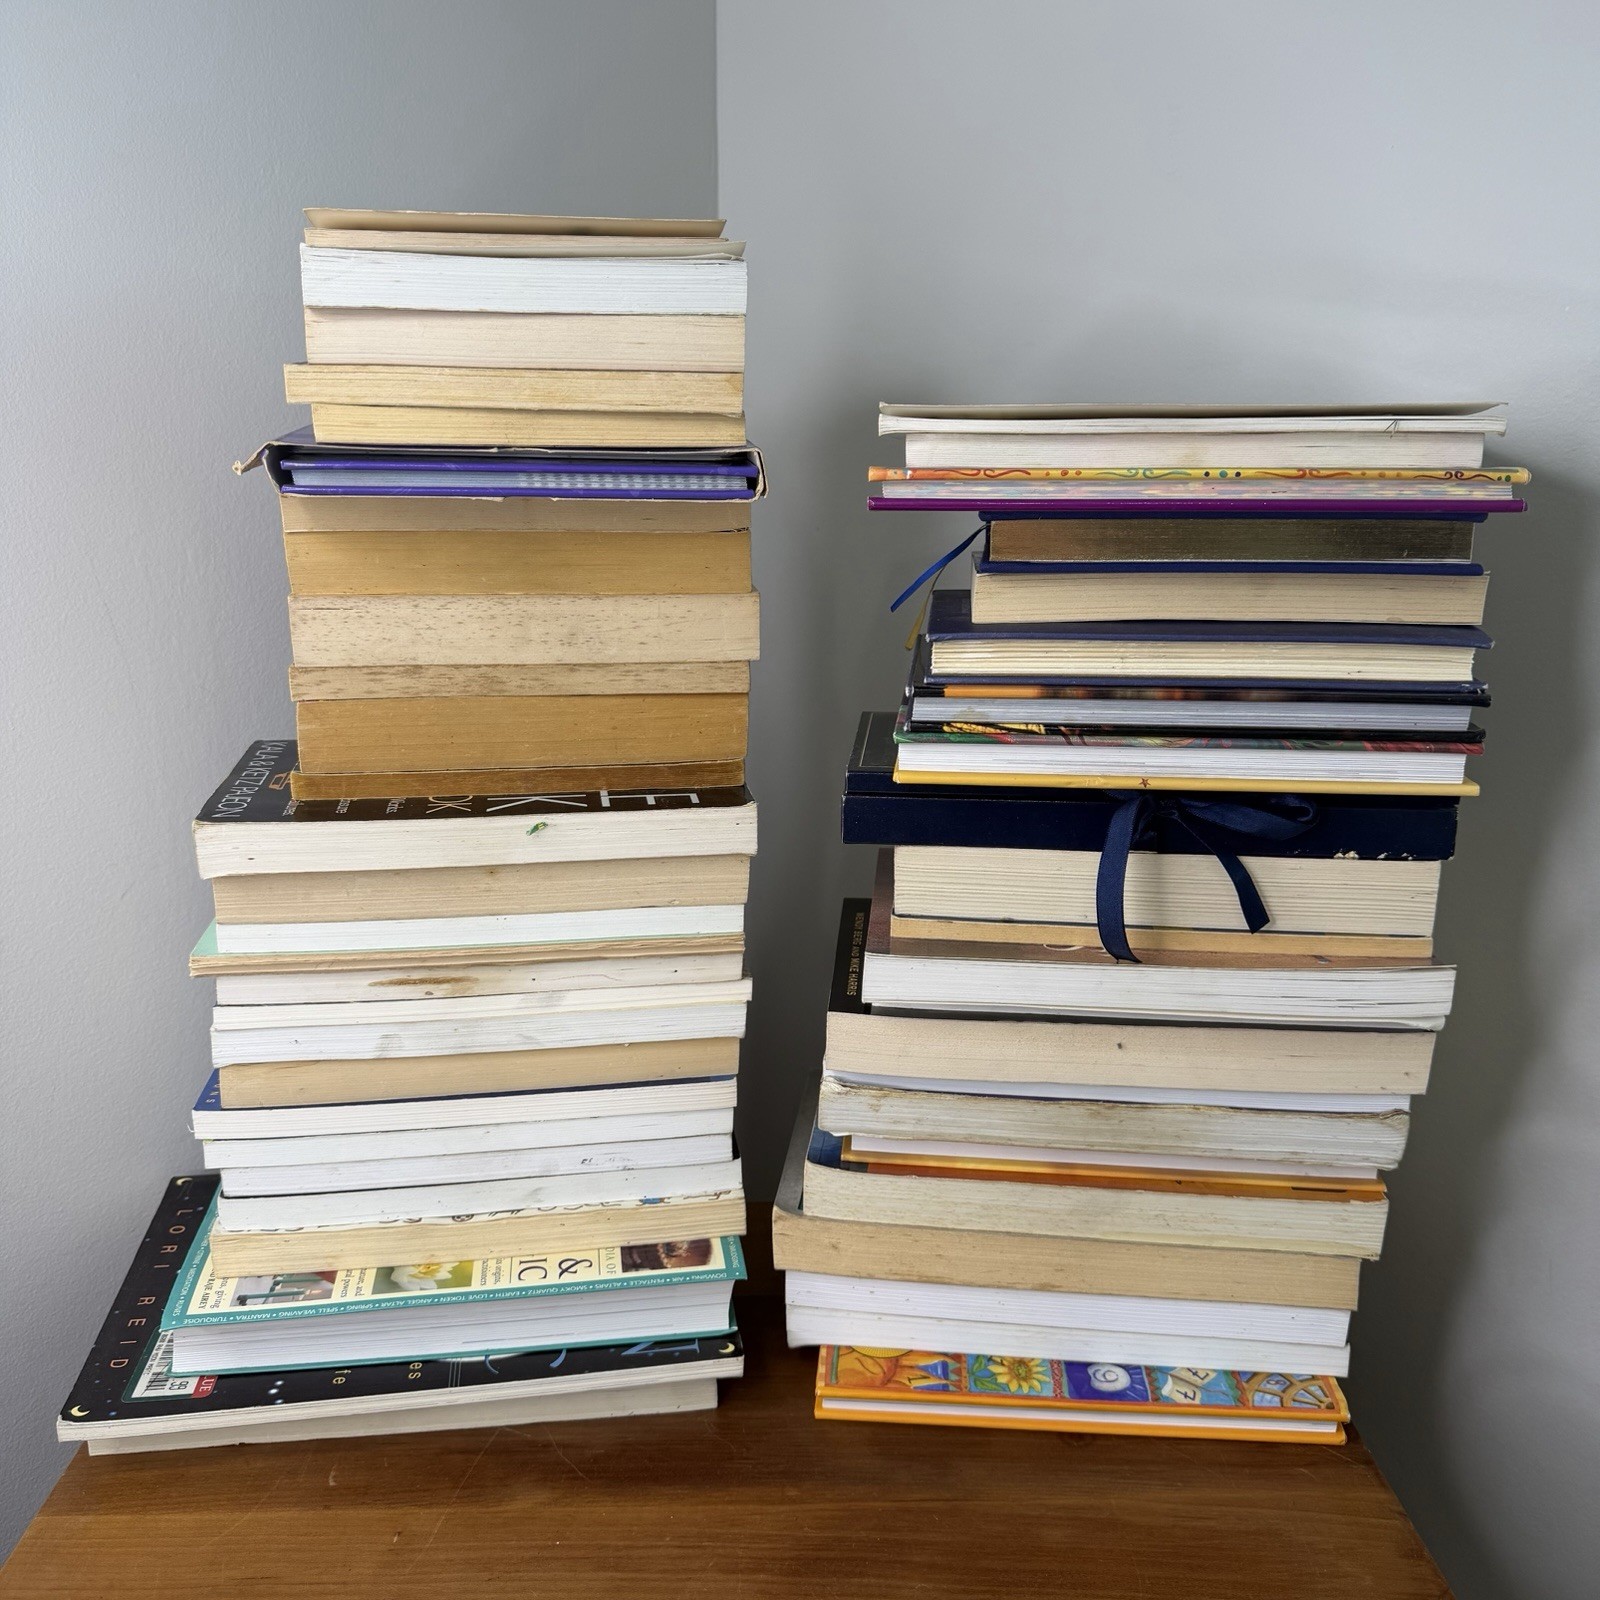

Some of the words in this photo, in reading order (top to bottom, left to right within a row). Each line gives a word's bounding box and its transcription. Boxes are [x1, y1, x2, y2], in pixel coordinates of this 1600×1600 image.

[253, 741, 289, 760] KALA
[234, 767, 271, 785] KETZ
[851, 946, 860, 957] AND
[849, 959, 860, 972] MIKE
[847, 974, 858, 996] HARRIS
[155, 1208, 193, 1268] LORI
[558, 1258, 592, 1278] &
[607, 1259, 616, 1274] OF
[180, 1267, 196, 1297] MEDITATION
[204, 1278, 215, 1293] RAJE
[561, 1284, 588, 1292] SMOKY
[595, 1281, 622, 1289] ALTARS
[630, 1278, 665, 1286] PENTACLE
[339, 1280, 352, 1298] powers
[526, 1286, 559, 1295] QUARTZ
[198, 1292, 211, 1309] AIREY
[210, 1290, 227, 1308] giving
[380, 1300, 407, 1308] ALTAR
[410, 1297, 432, 1305] ANGEL
[440, 1294, 466, 1304] TOKEN
[173, 1299, 183, 1316] RUNES
[282, 1307, 315, 1316] WEAVING
[318, 1304, 338, 1314] SPELL
[346, 1302, 373, 1311] SPRING
[183, 1316, 227, 1325] TURQUOISE
[235, 1312, 270, 1321] MANTRA
[111, 1296, 155, 1368] REID
